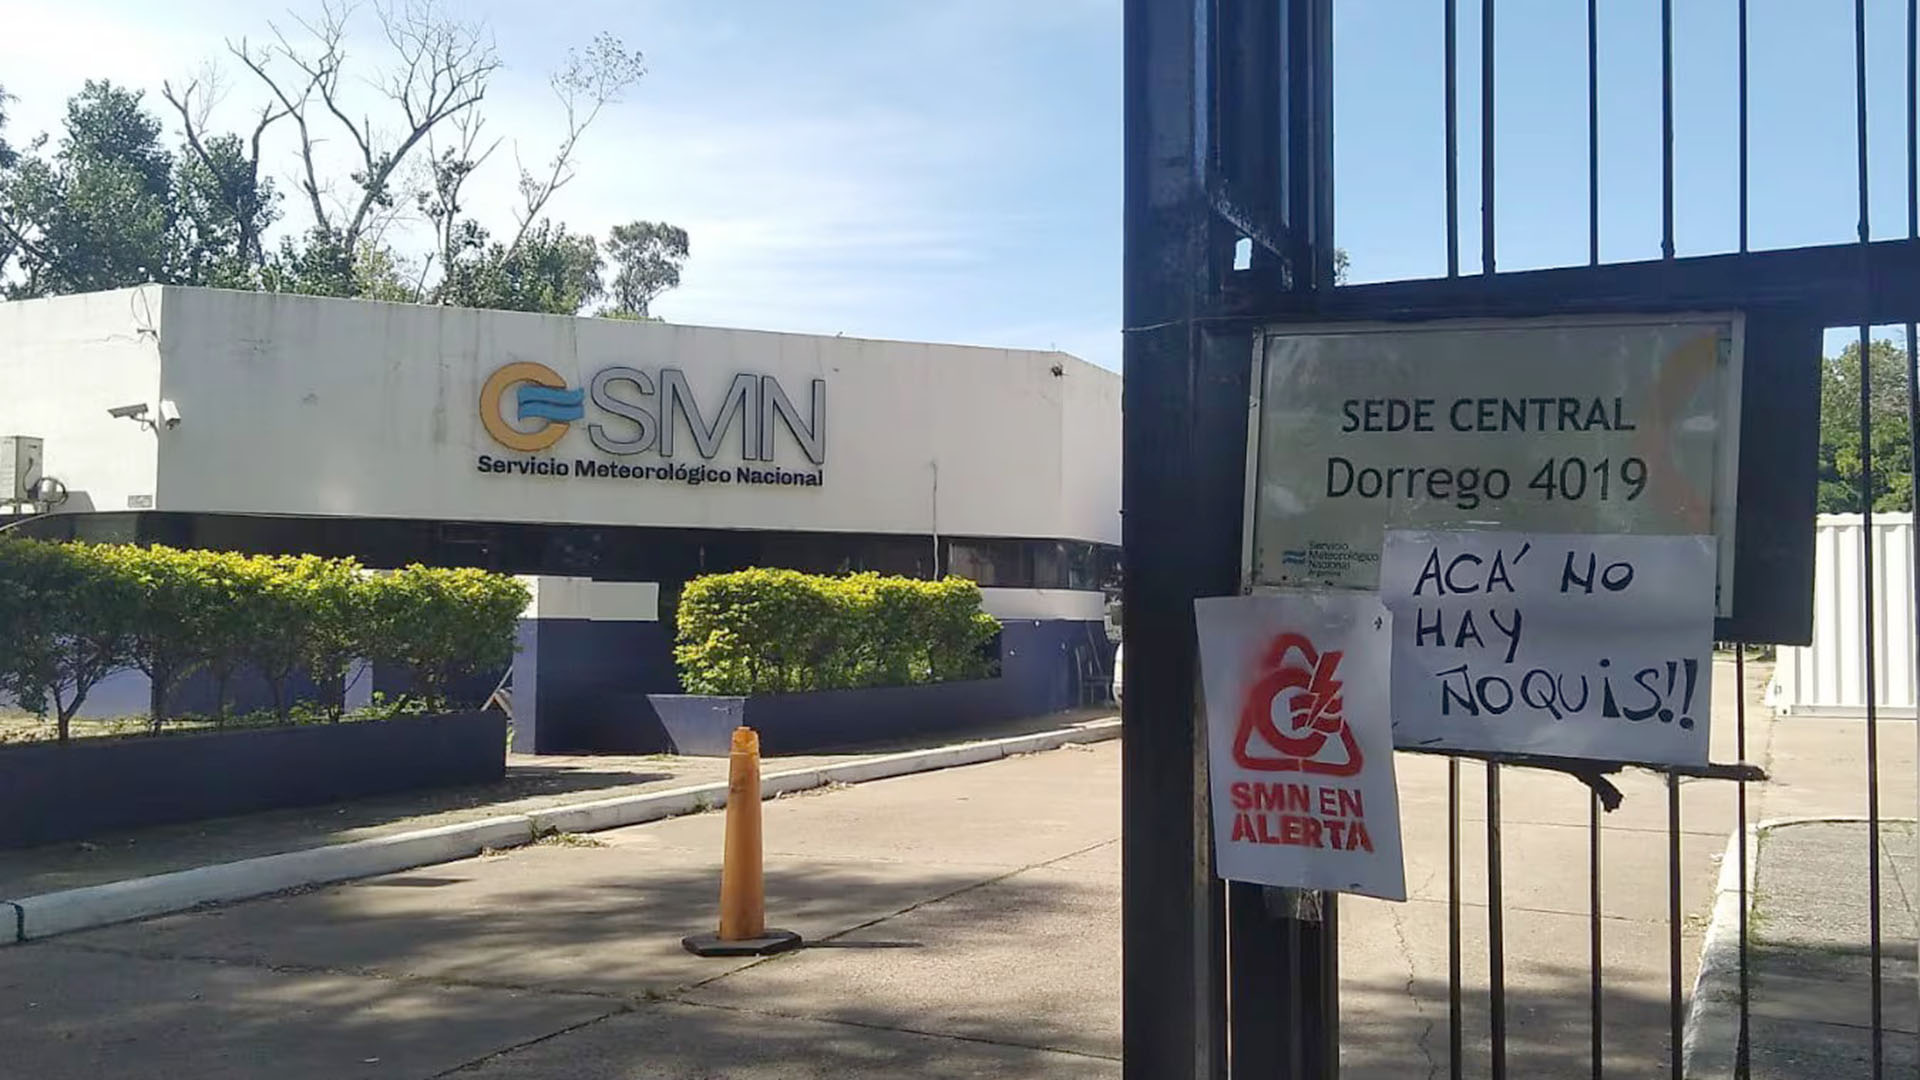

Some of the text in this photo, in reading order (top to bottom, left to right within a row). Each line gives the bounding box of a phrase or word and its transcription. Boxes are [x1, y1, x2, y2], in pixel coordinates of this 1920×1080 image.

[588, 366, 826, 465] SMN
[1342, 396, 1636, 433] SEDE CENTRAL
[478, 455, 824, 487] Servicio Meteorológico Nacional
[1327, 456, 1648, 510] Dorrego 4019
[1560, 551, 1634, 593] NO
[1416, 608, 1521, 663] HAY
[1230, 782, 1364, 817] SMN EN
[1231, 813, 1375, 853] ALERTA
